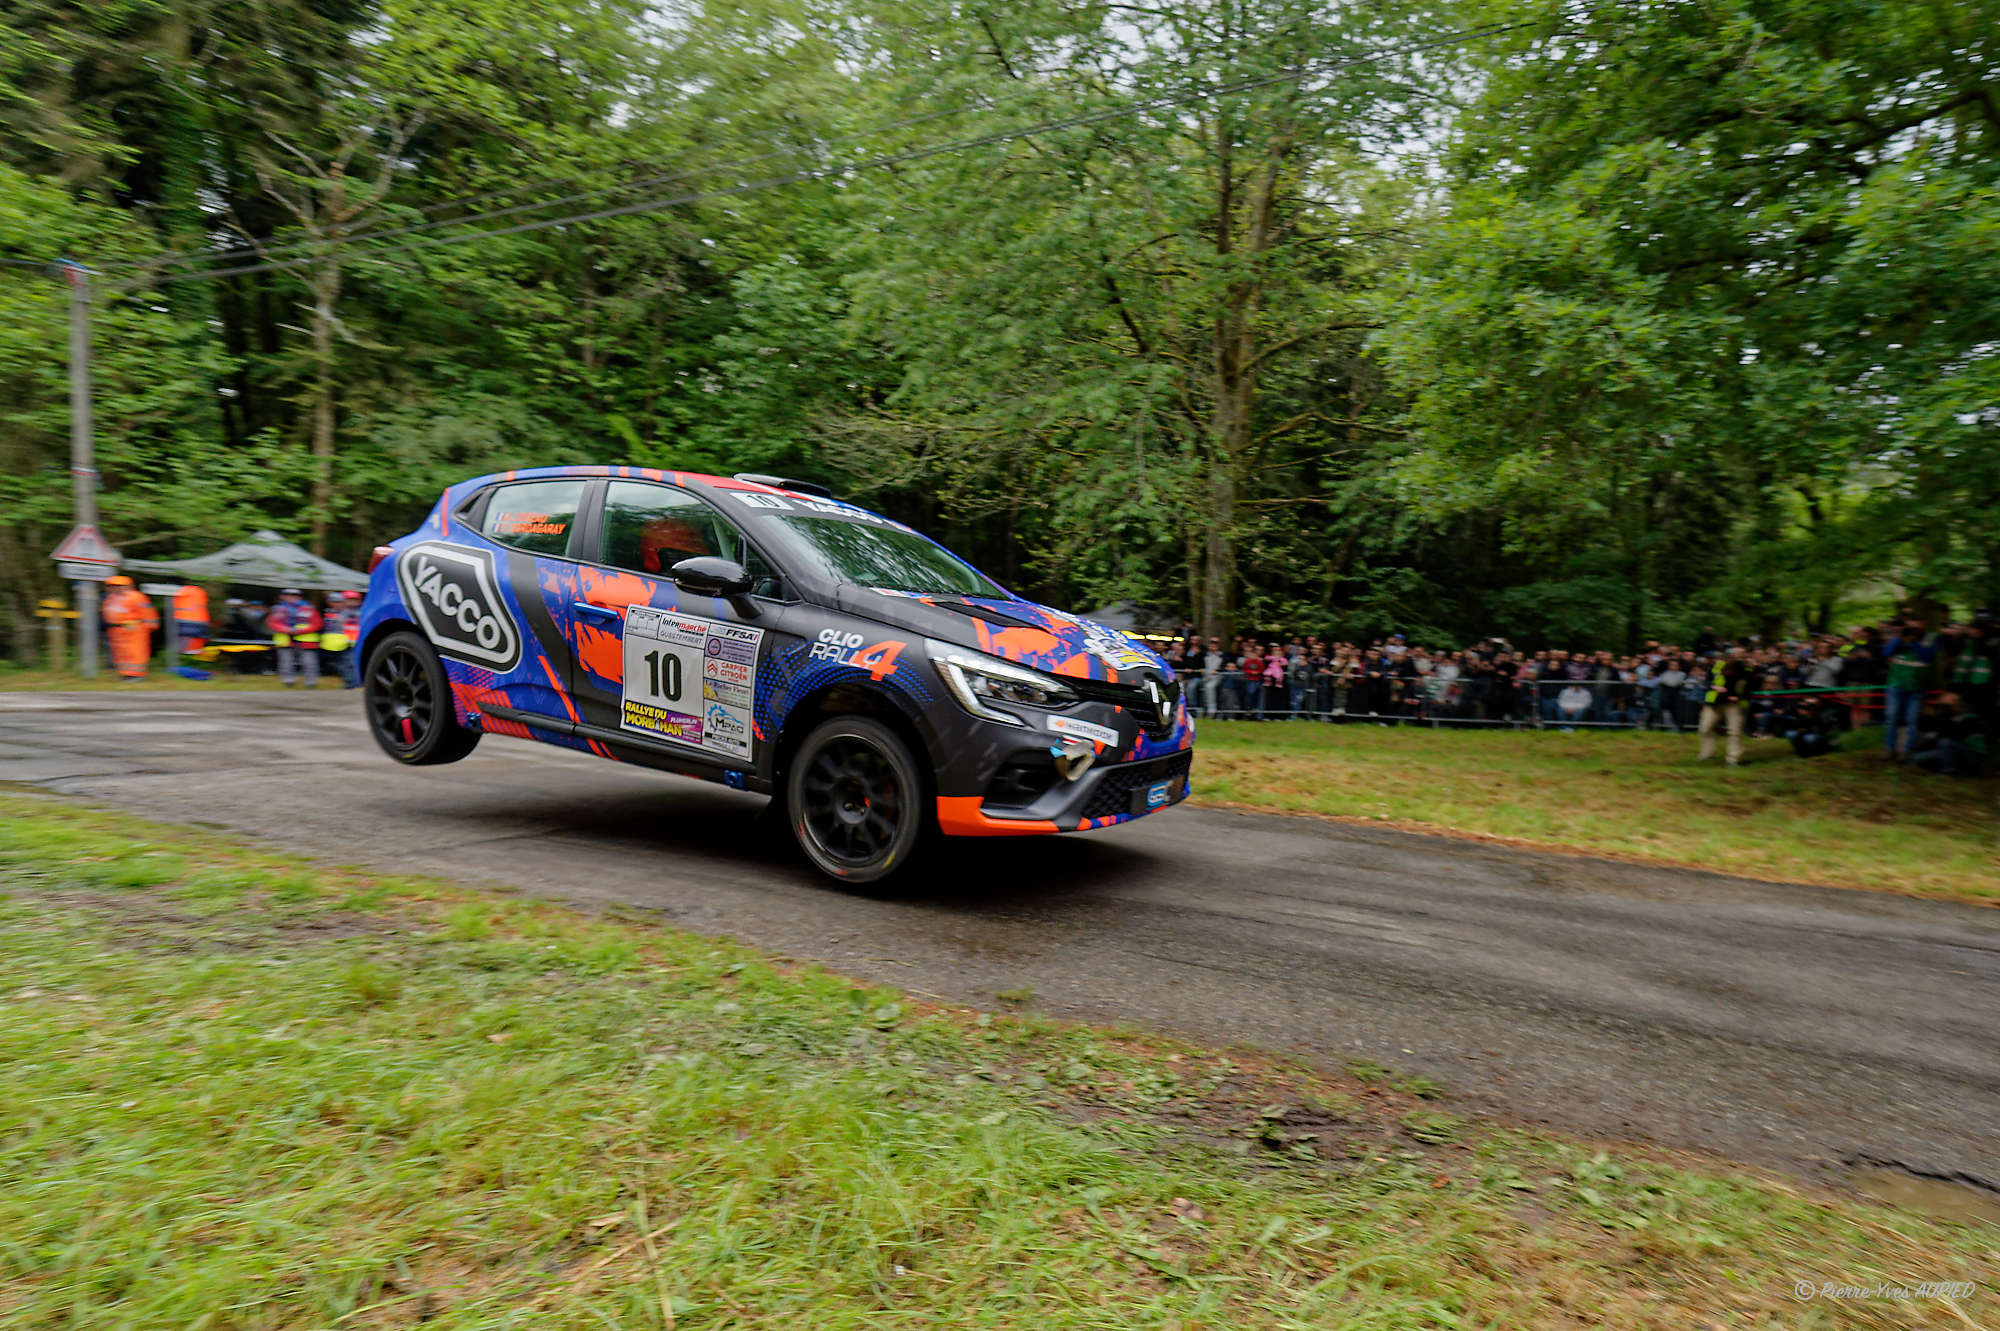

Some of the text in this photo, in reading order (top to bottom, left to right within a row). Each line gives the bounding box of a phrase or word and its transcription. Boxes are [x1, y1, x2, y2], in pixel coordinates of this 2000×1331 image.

[414, 556, 501, 649] YACCO
[660, 631, 703, 645] QUESTEMBERT
[726, 629, 753, 640] FFSA
[818, 628, 864, 648] CLIO
[808, 640, 908, 682] RALLY 4
[644, 650, 682, 702] 10
[625, 700, 667, 720] RALLYE DU
